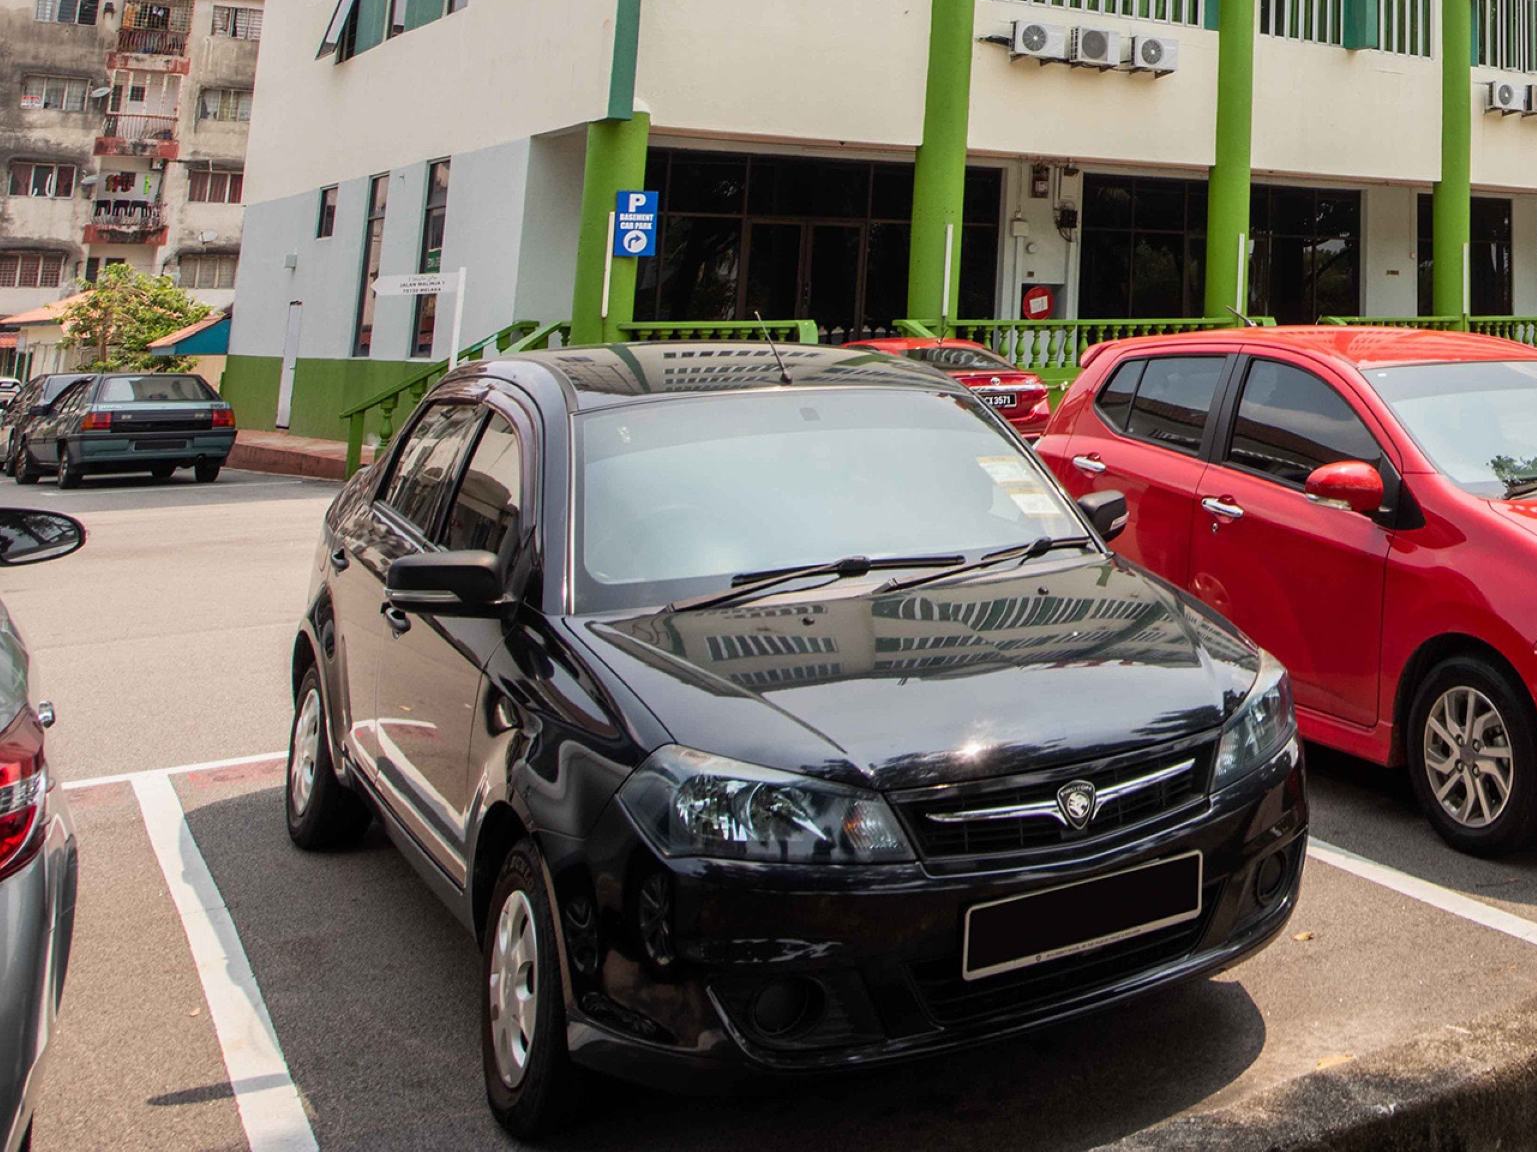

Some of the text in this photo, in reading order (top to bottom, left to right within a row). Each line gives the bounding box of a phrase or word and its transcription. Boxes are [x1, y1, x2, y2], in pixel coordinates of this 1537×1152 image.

[628, 193, 647, 213] P
[620, 222, 653, 230] CAR PARK
